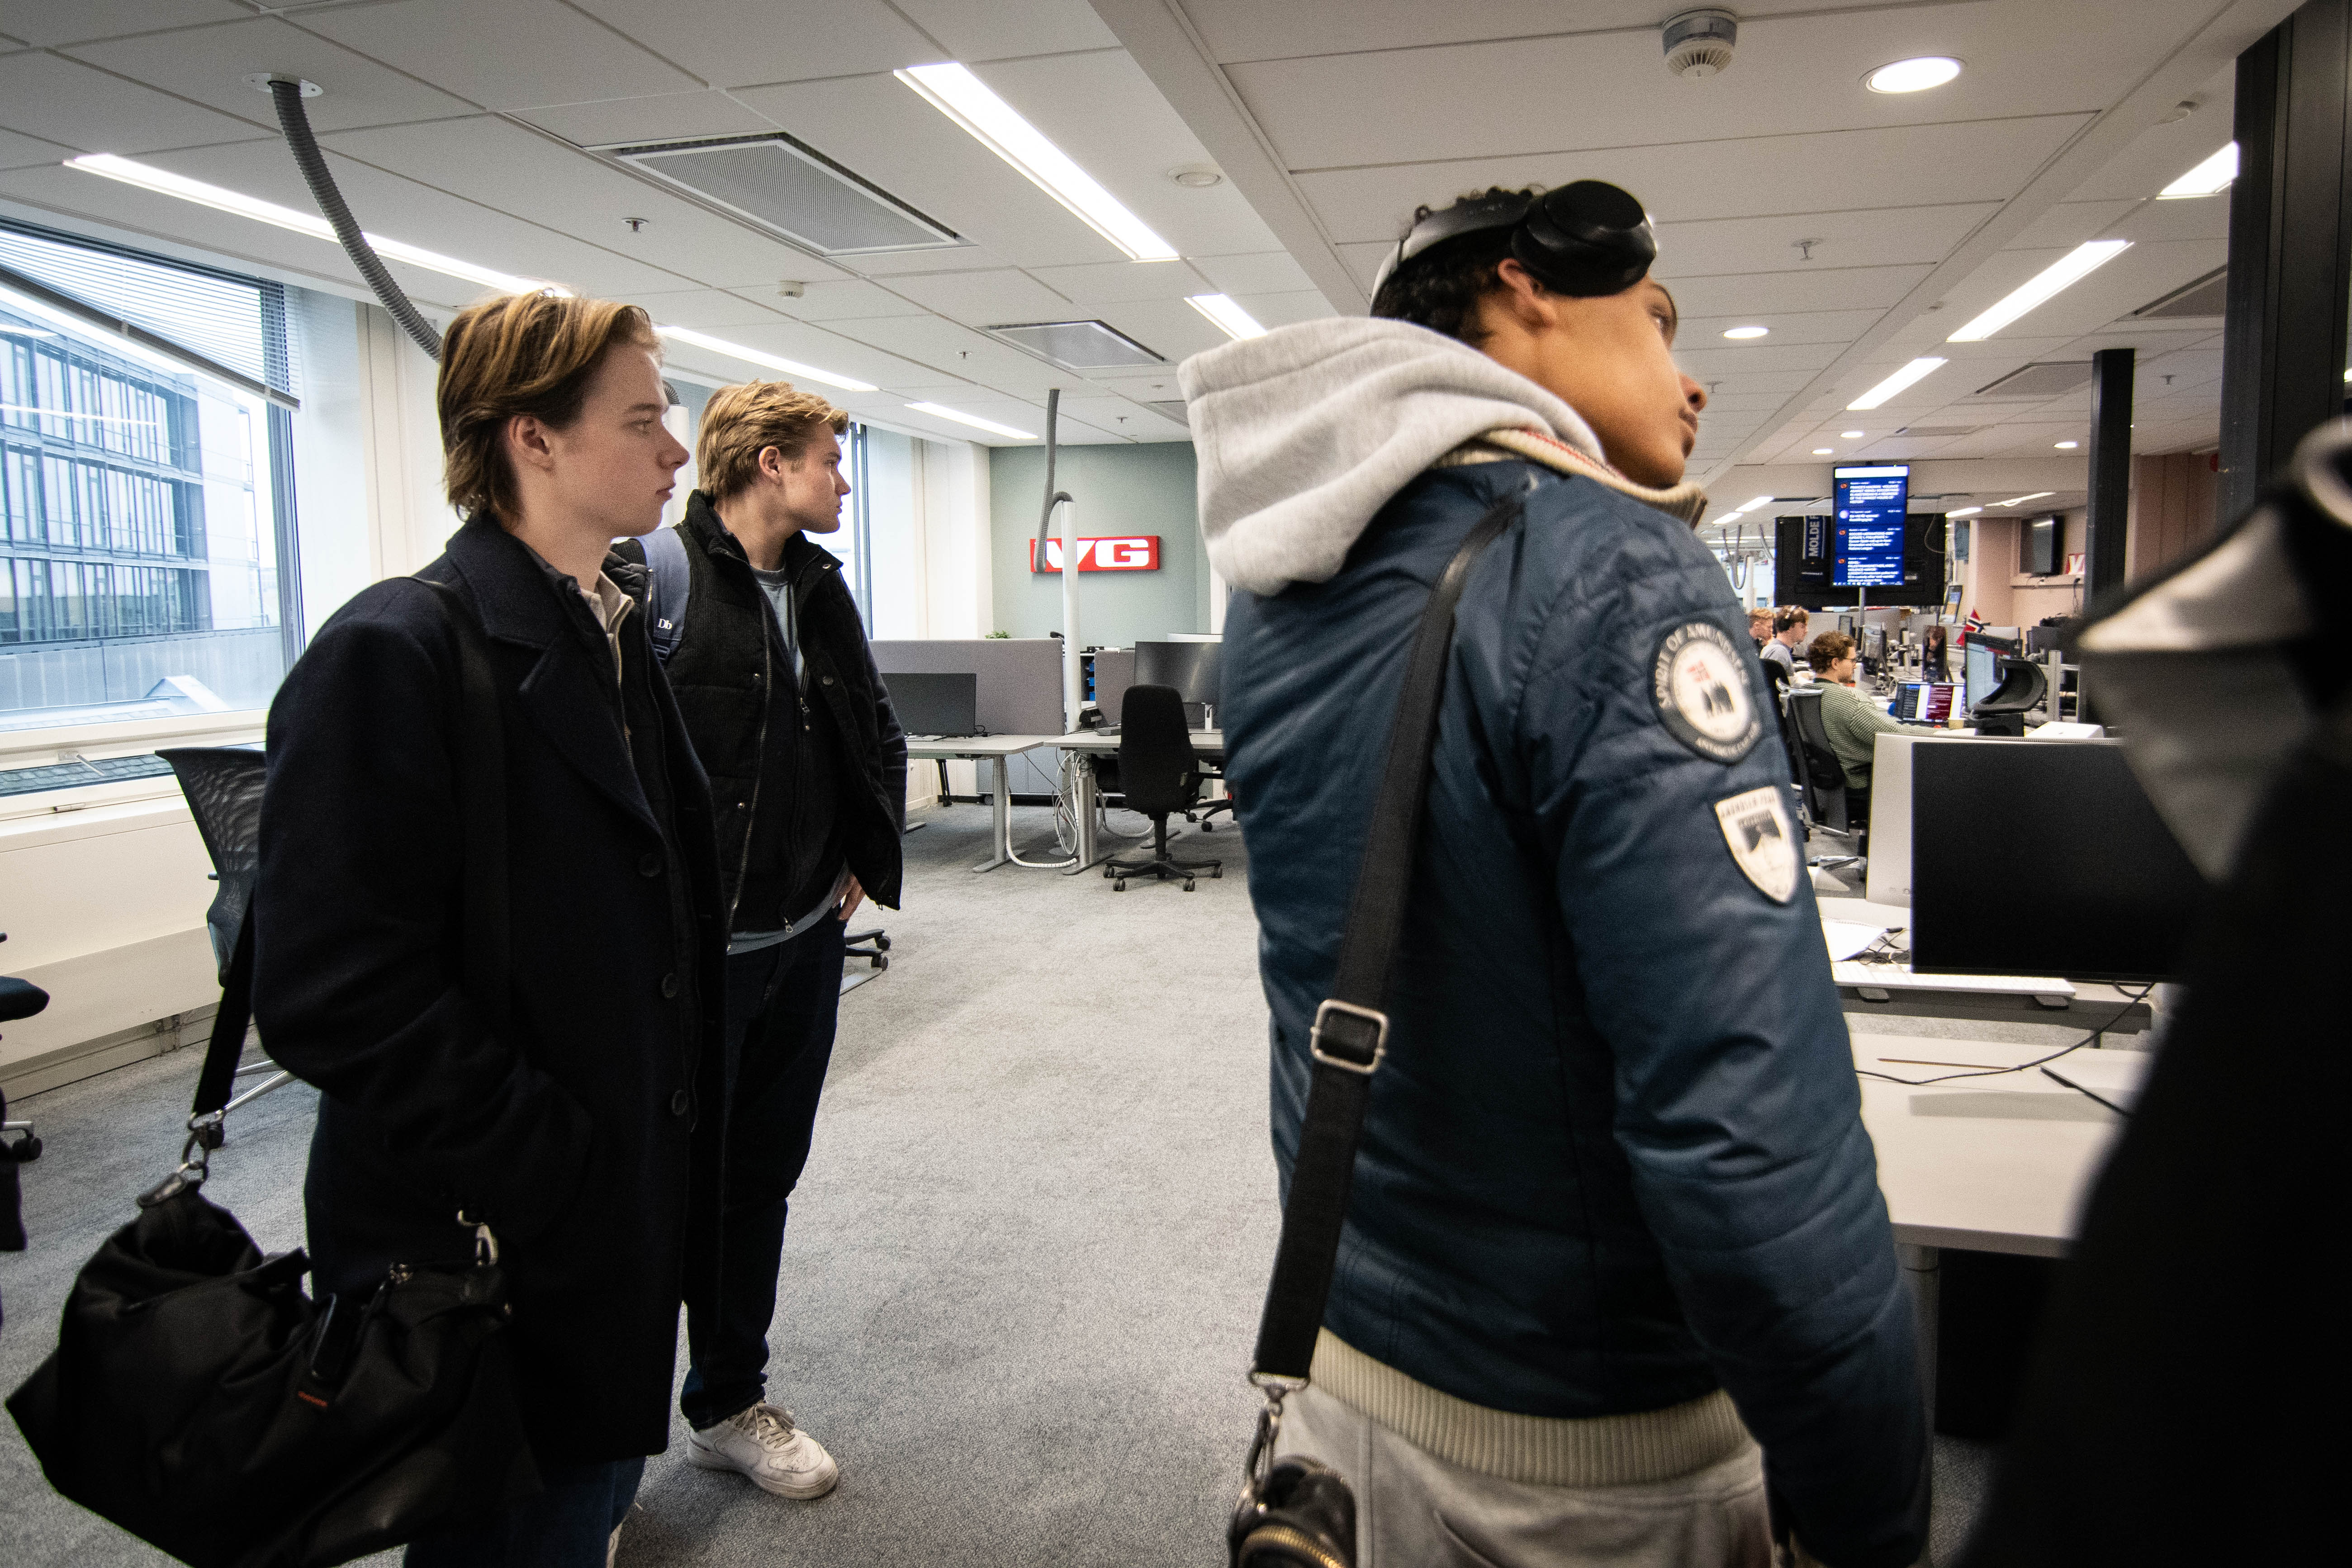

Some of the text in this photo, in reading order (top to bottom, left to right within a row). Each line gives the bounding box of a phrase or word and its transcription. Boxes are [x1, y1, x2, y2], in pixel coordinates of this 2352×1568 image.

[1808, 521, 1819, 556] MOLDE
[1034, 539, 1149, 568] VG
[2068, 554, 2085, 571] V
[658, 618, 673, 630] Db
